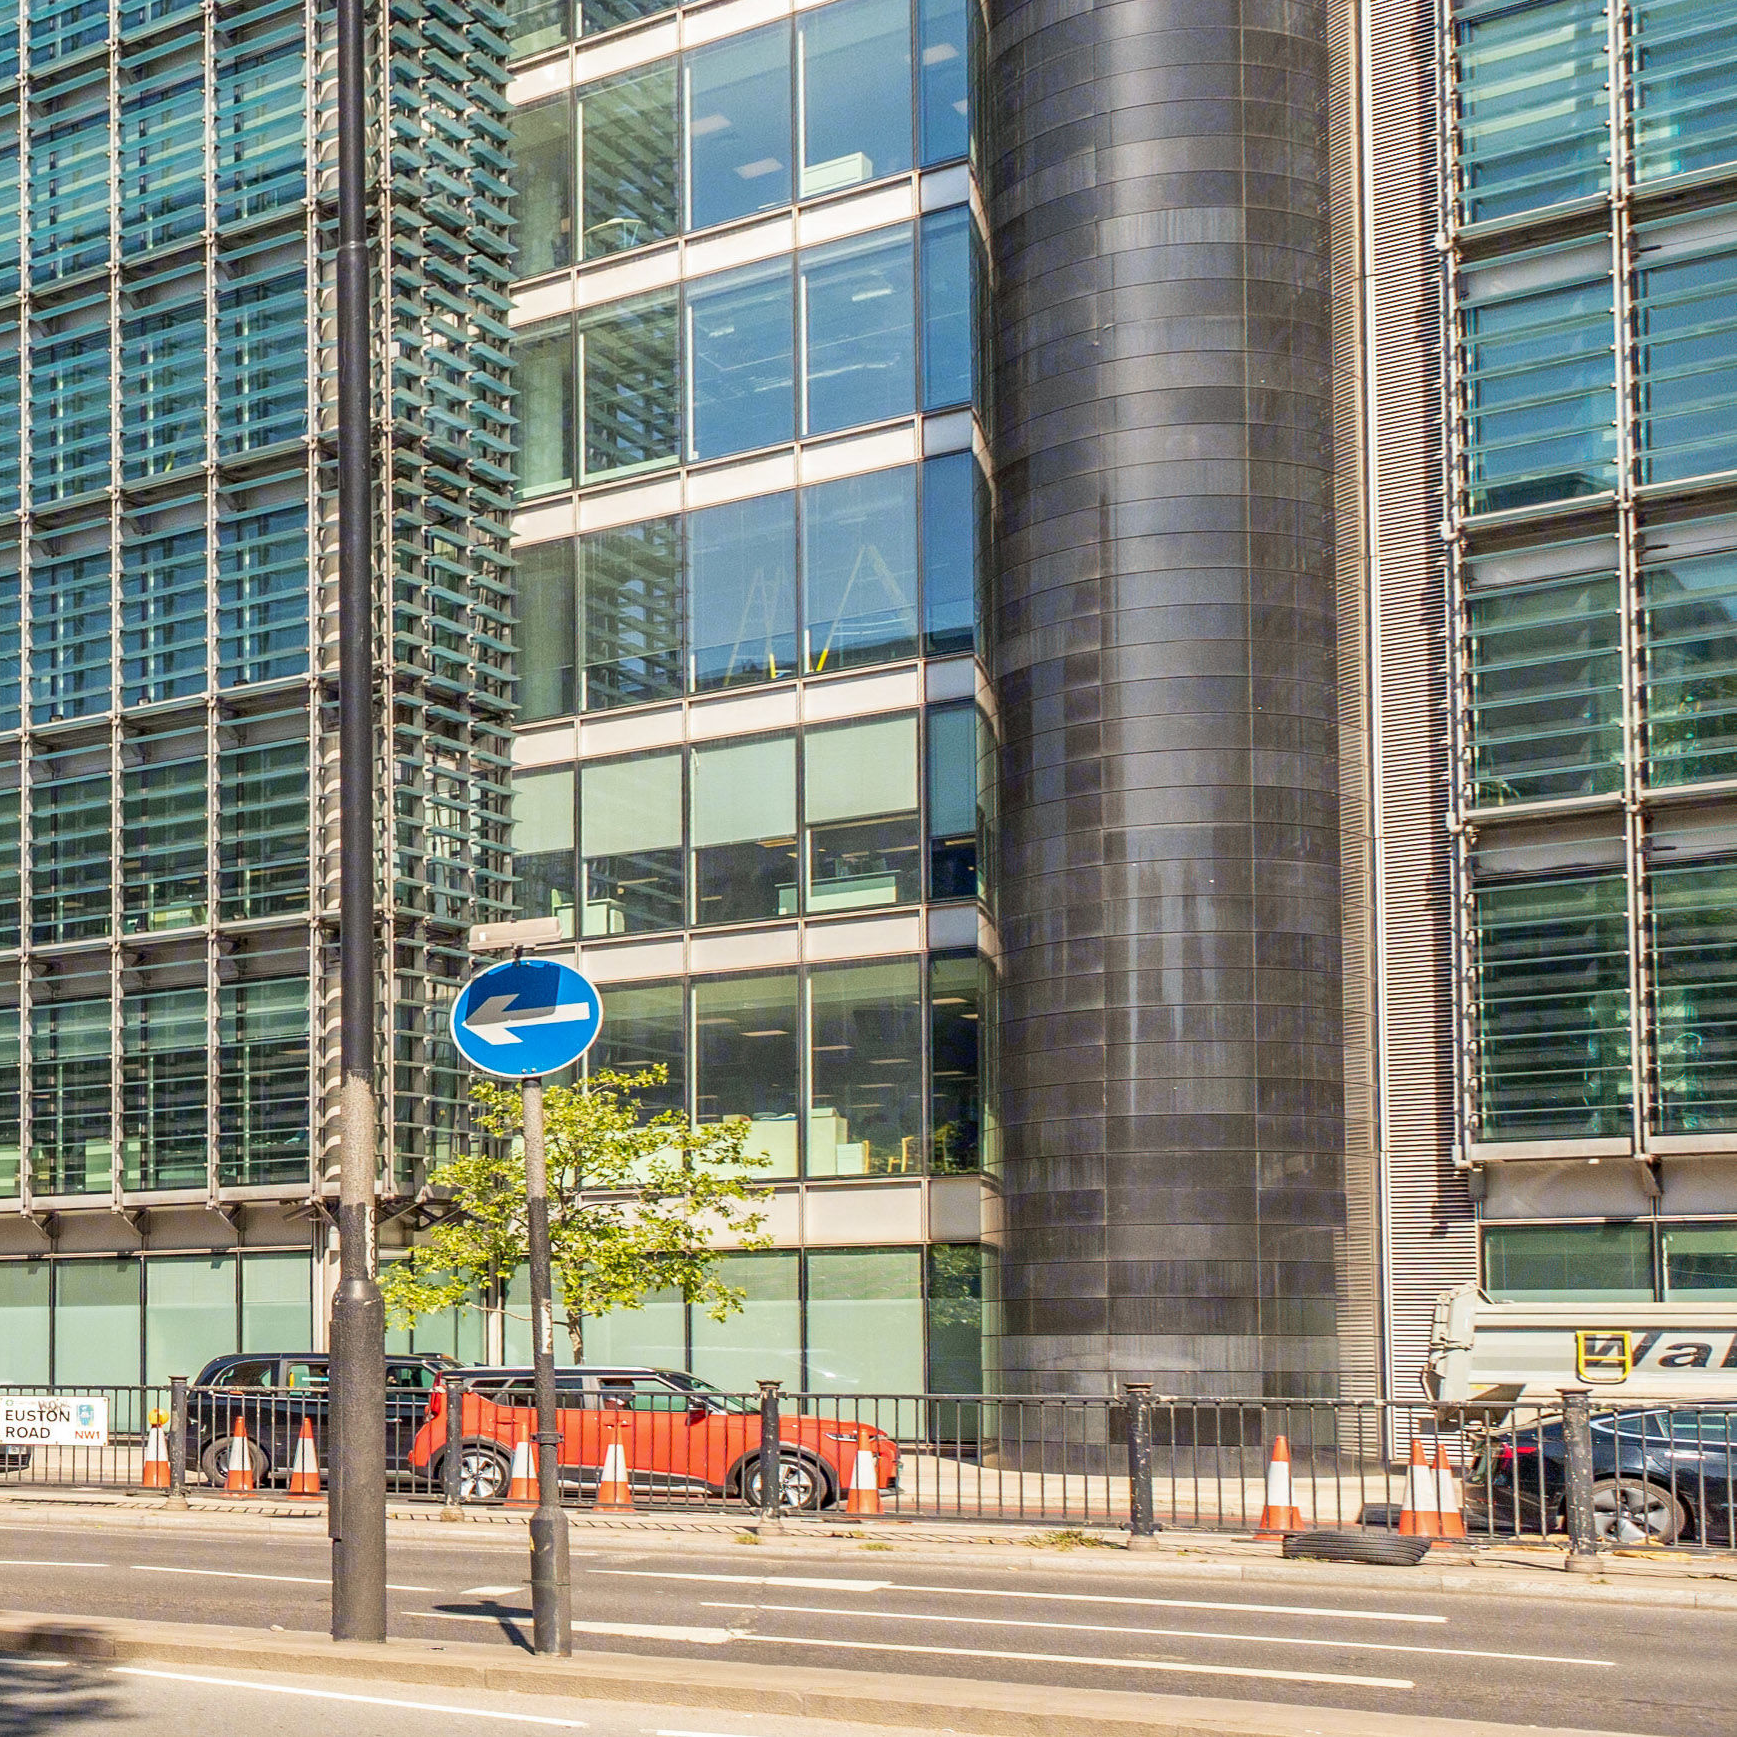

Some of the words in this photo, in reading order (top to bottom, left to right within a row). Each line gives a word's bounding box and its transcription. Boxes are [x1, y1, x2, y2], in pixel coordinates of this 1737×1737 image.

[6, 1410, 70, 1422] EUSTON
[6, 1427, 50, 1438] ROAD
[75, 1430, 100, 1439] NW1
